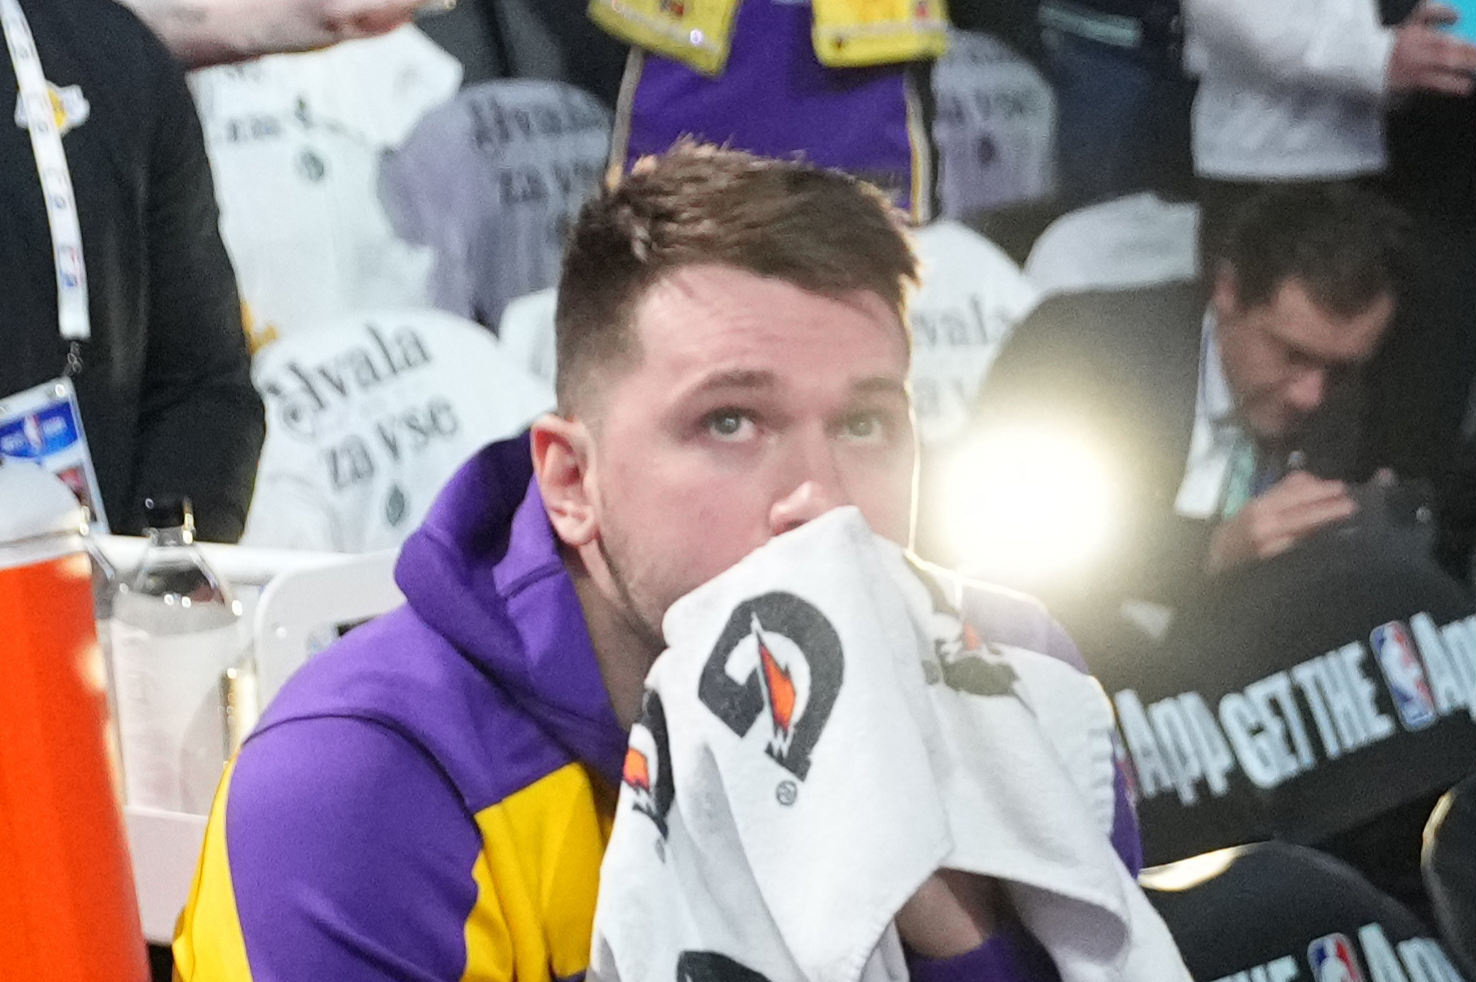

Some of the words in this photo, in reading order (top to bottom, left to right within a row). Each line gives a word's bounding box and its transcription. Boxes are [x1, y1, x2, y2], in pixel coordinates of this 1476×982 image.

[1114, 687, 1235, 806] App
[1218, 670, 1317, 789] GET
[1291, 641, 1397, 760] THE
